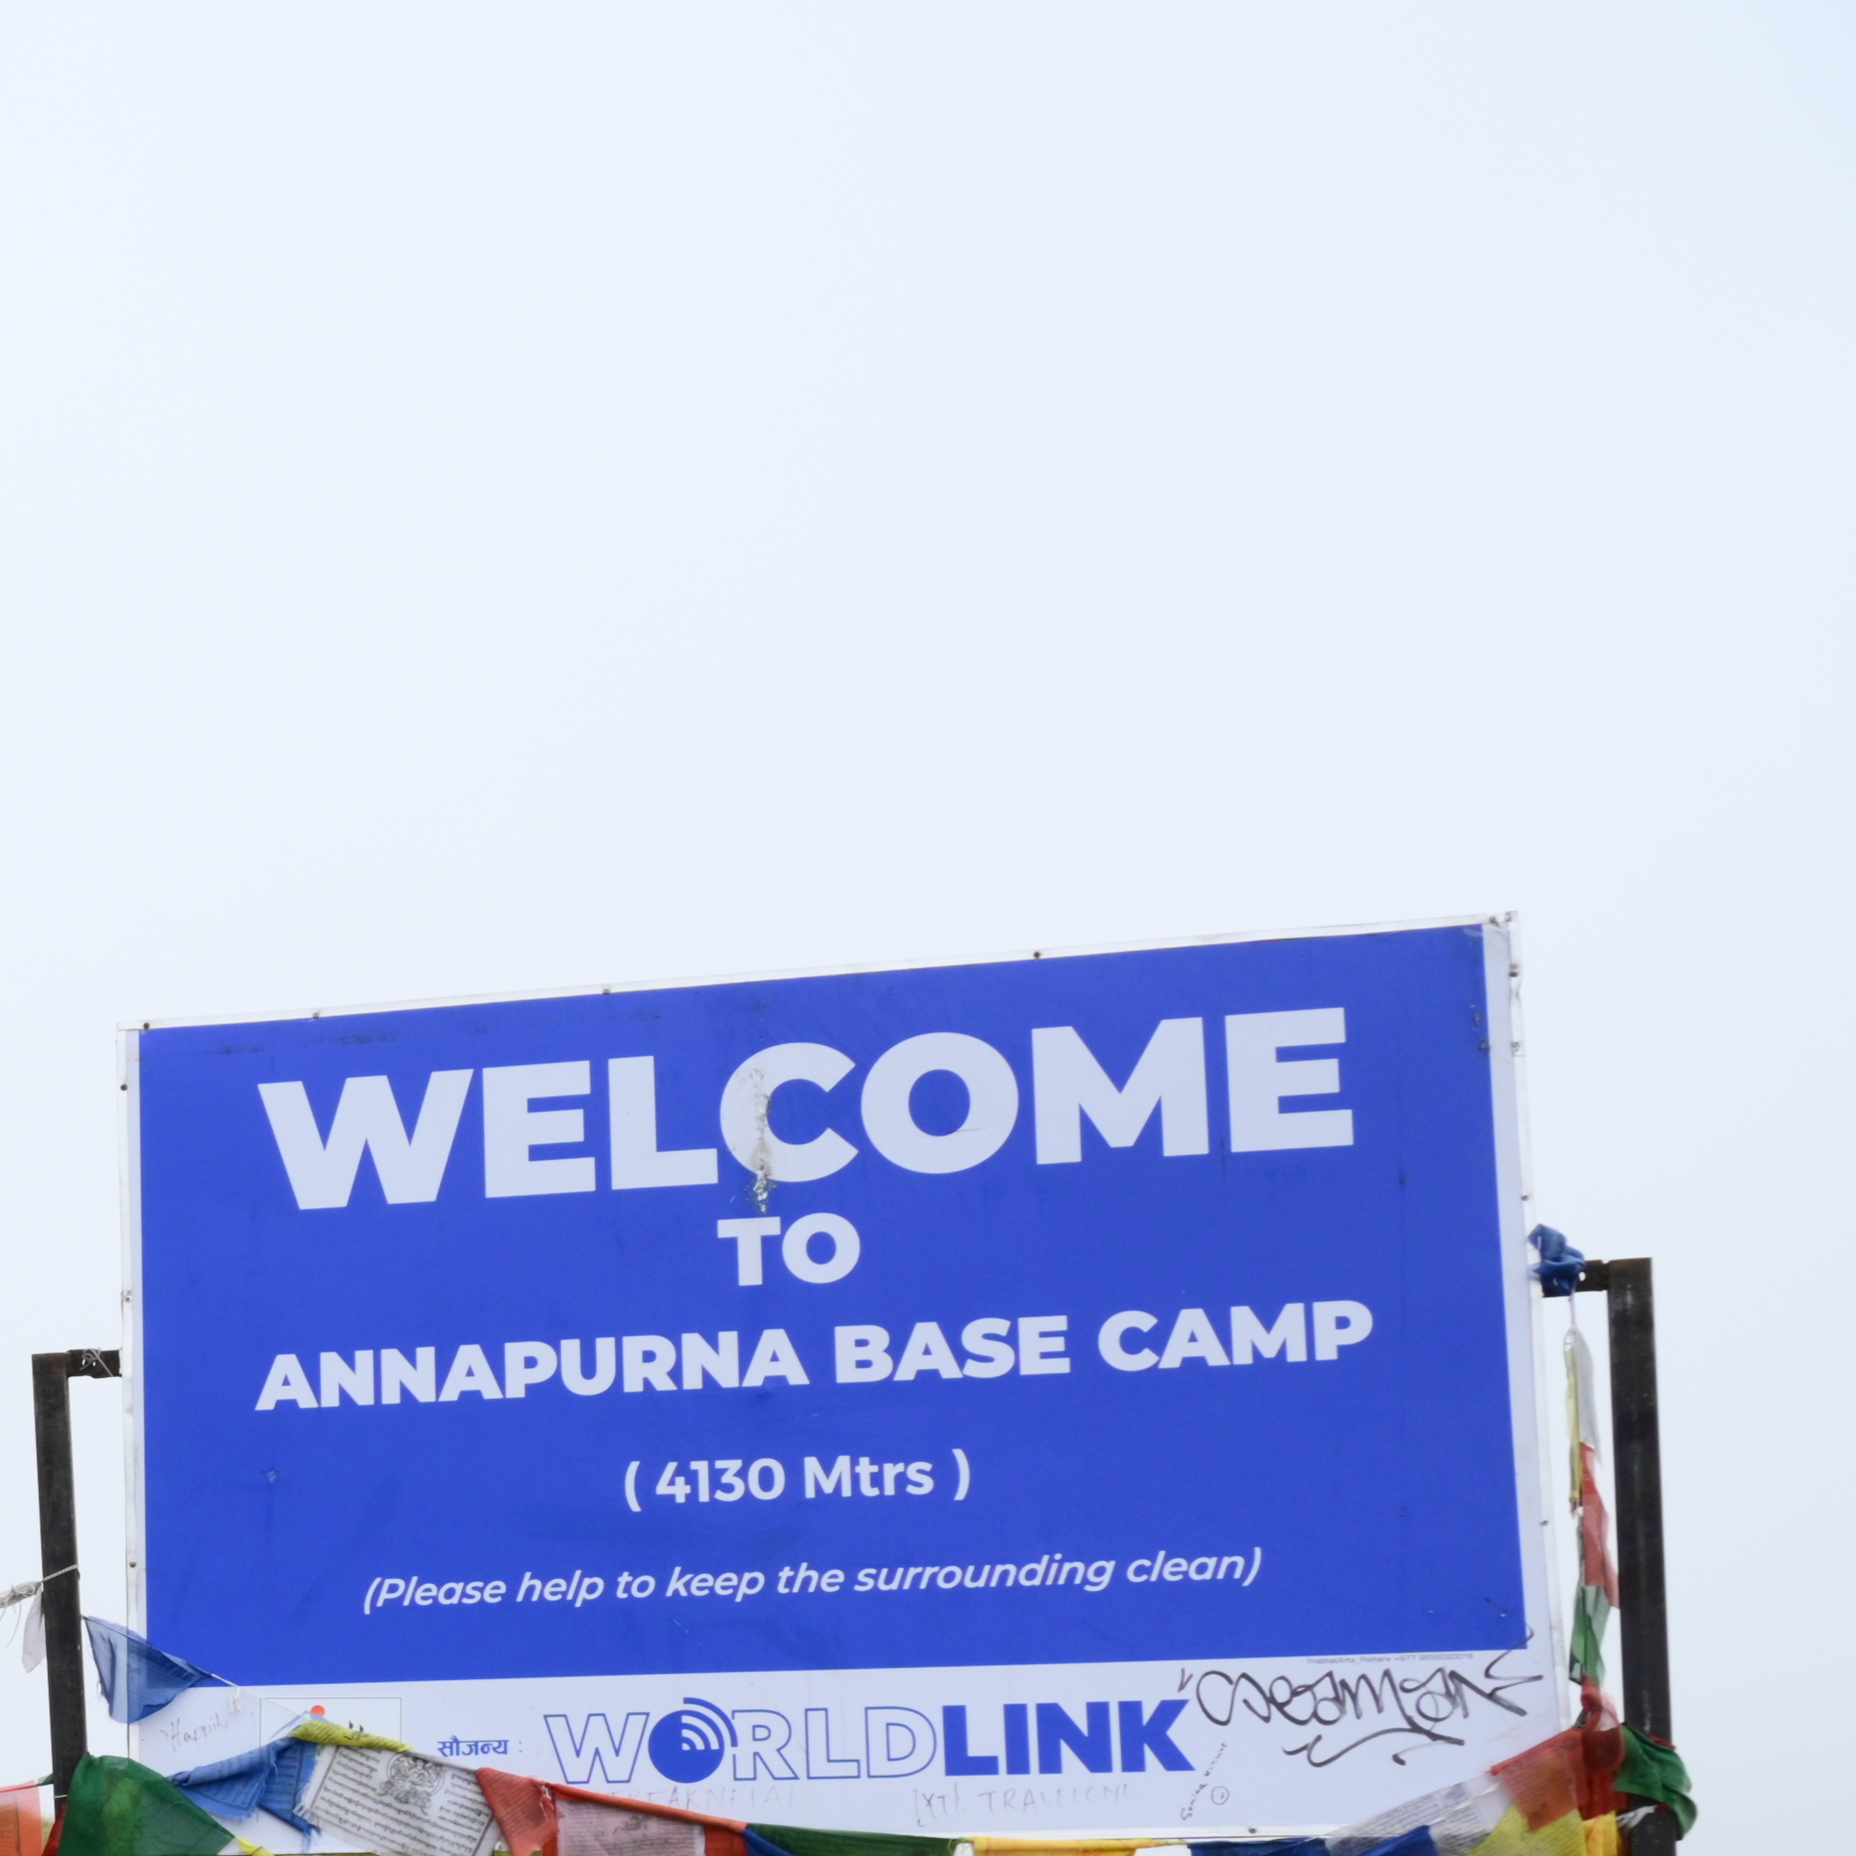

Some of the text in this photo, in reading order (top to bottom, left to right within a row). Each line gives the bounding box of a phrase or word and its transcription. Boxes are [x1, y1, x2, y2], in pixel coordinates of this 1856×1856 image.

[258, 1008, 1353, 1210] WELCOME
[718, 1213, 860, 1286] TO
[256, 1301, 1372, 1410] ANNAPURNA BASE CAMP
[365, 1547, 1262, 1614] (Please help to keep the surrounding clean)
